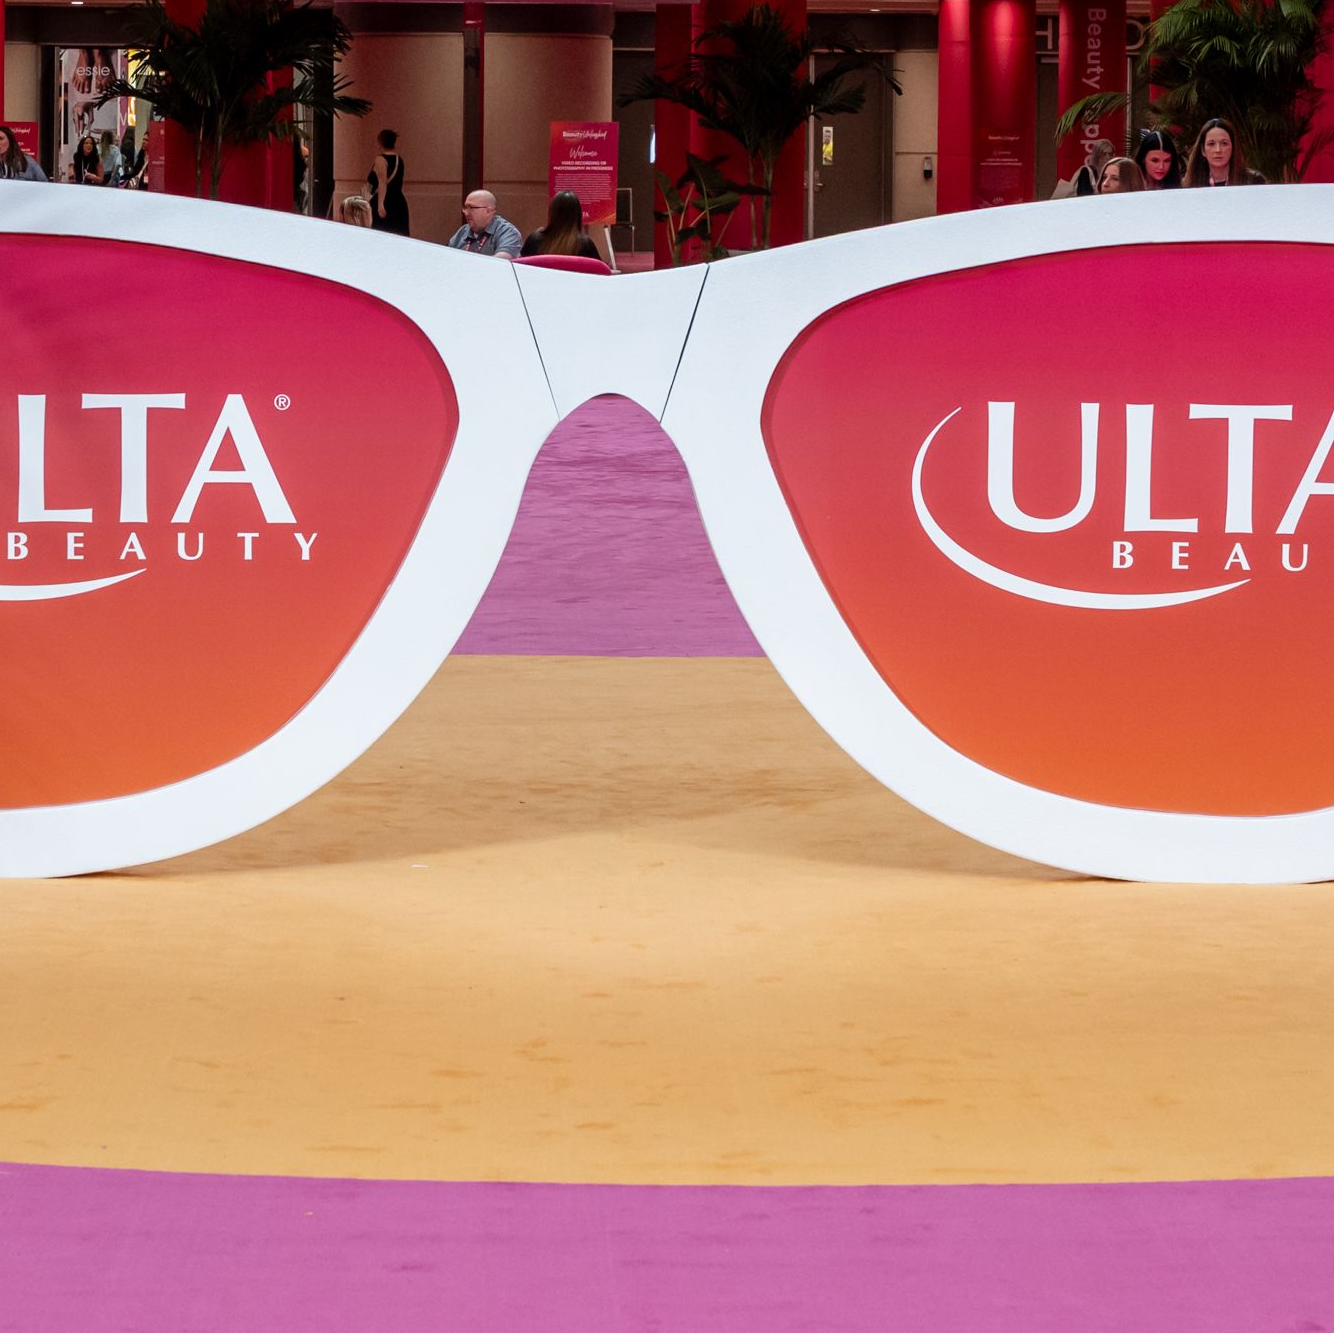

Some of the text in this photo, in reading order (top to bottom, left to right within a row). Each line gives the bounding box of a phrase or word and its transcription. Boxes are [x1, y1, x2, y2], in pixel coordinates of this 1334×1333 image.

[1082, 8, 1107, 89] Beauty
[76, 65, 111, 76] essie
[6, 532, 318, 561] BEAUTY
